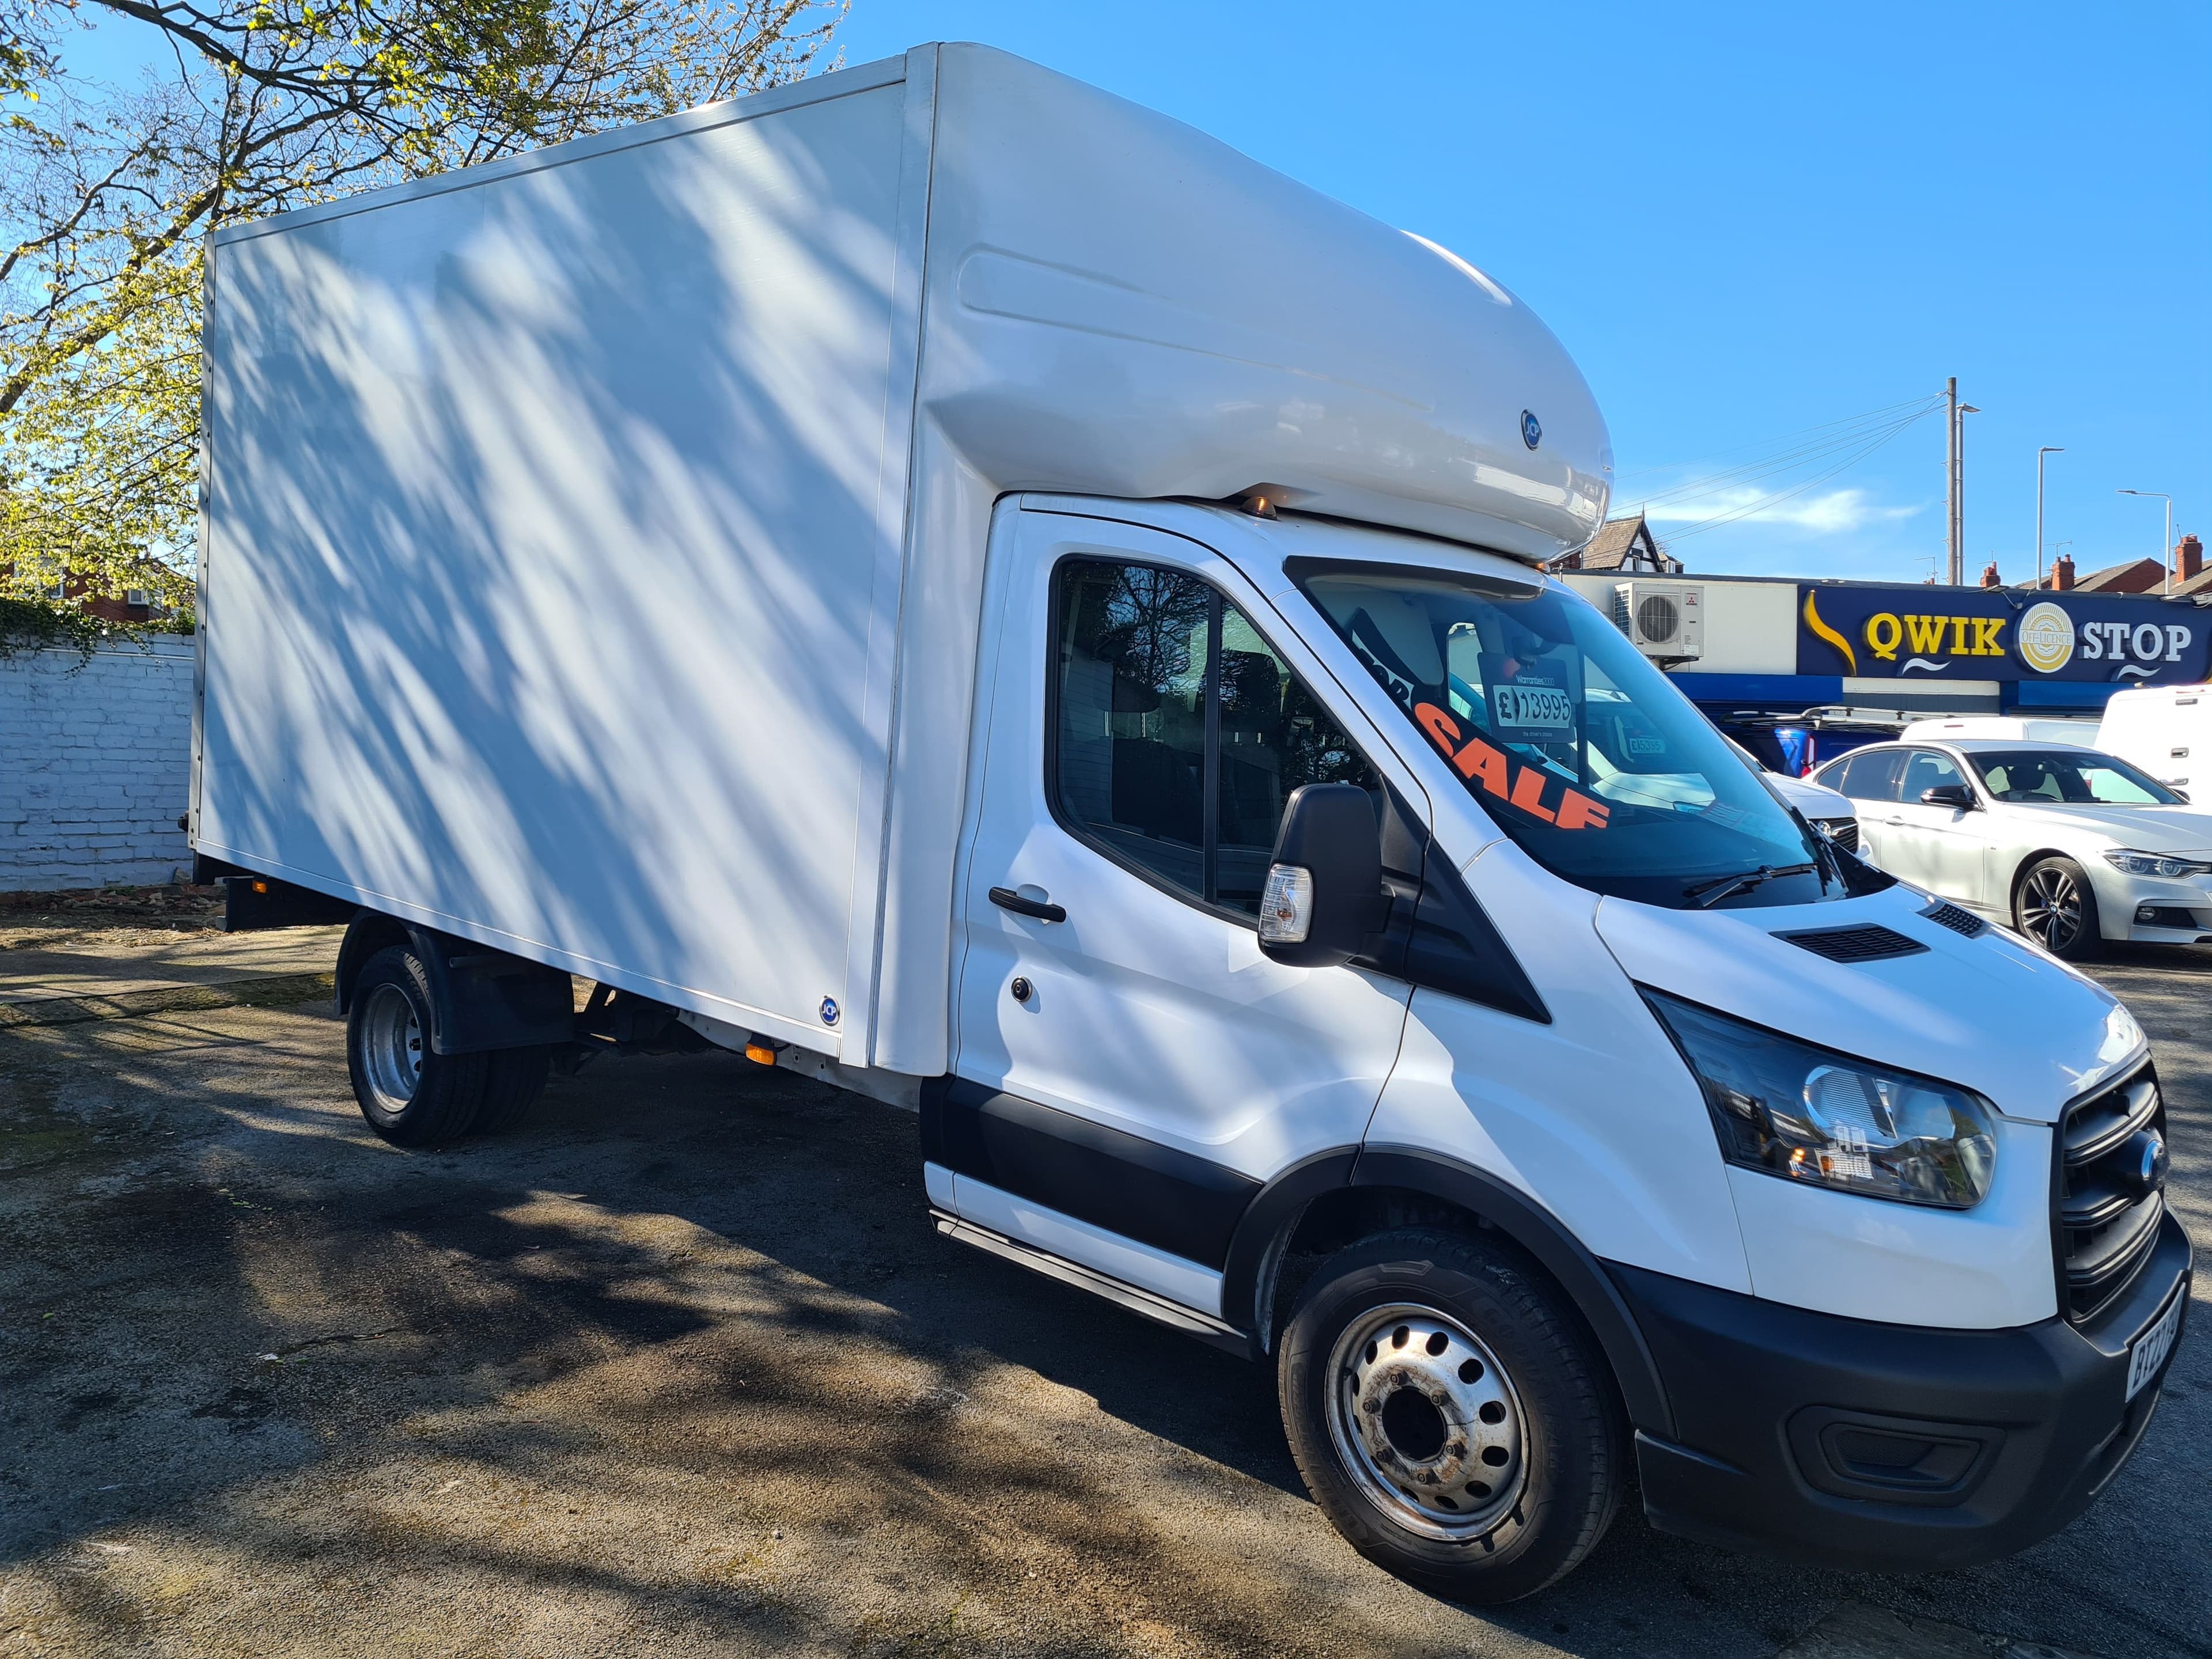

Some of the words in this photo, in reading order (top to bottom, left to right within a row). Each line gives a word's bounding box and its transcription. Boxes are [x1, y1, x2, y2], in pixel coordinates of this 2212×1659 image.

[1866, 612, 2006, 661] QWIK
[2022, 631, 2071, 644] OFF-LICENCE
[2082, 622, 2191, 662] STOP
